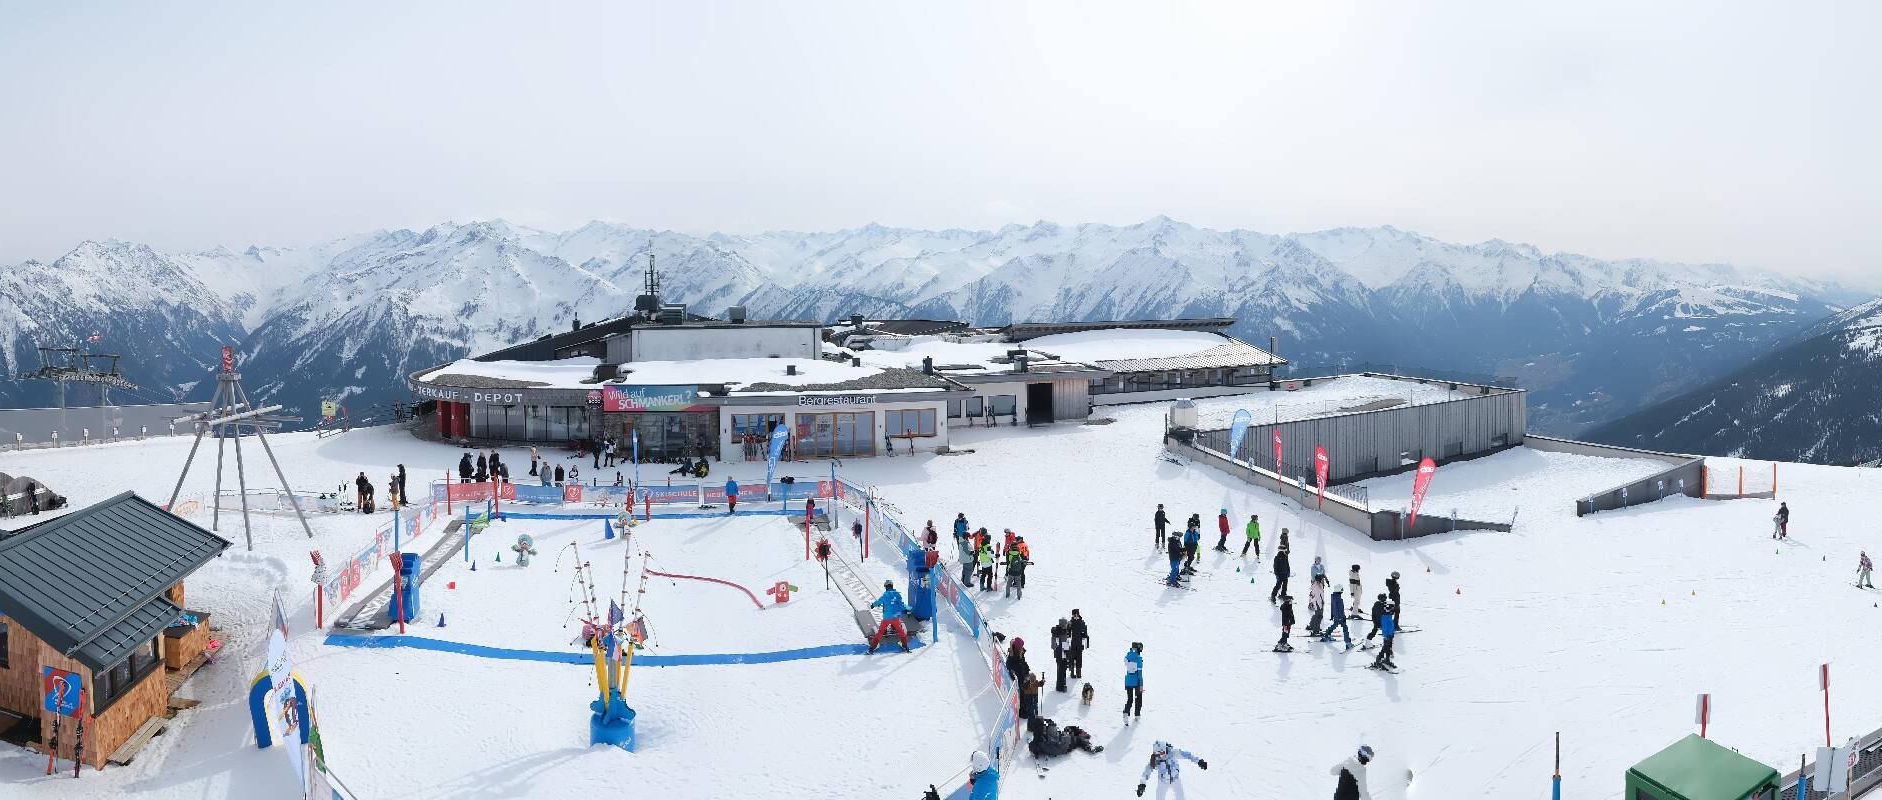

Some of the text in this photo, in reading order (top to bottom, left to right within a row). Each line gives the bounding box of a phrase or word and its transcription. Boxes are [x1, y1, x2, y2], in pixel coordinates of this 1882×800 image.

[474, 392, 523, 403] DEPOT
[608, 389, 628, 400] Wild
[630, 387, 645, 399] auf
[798, 395, 876, 406] Bergrestaurant
[654, 489, 698, 498] SKISCHULE
